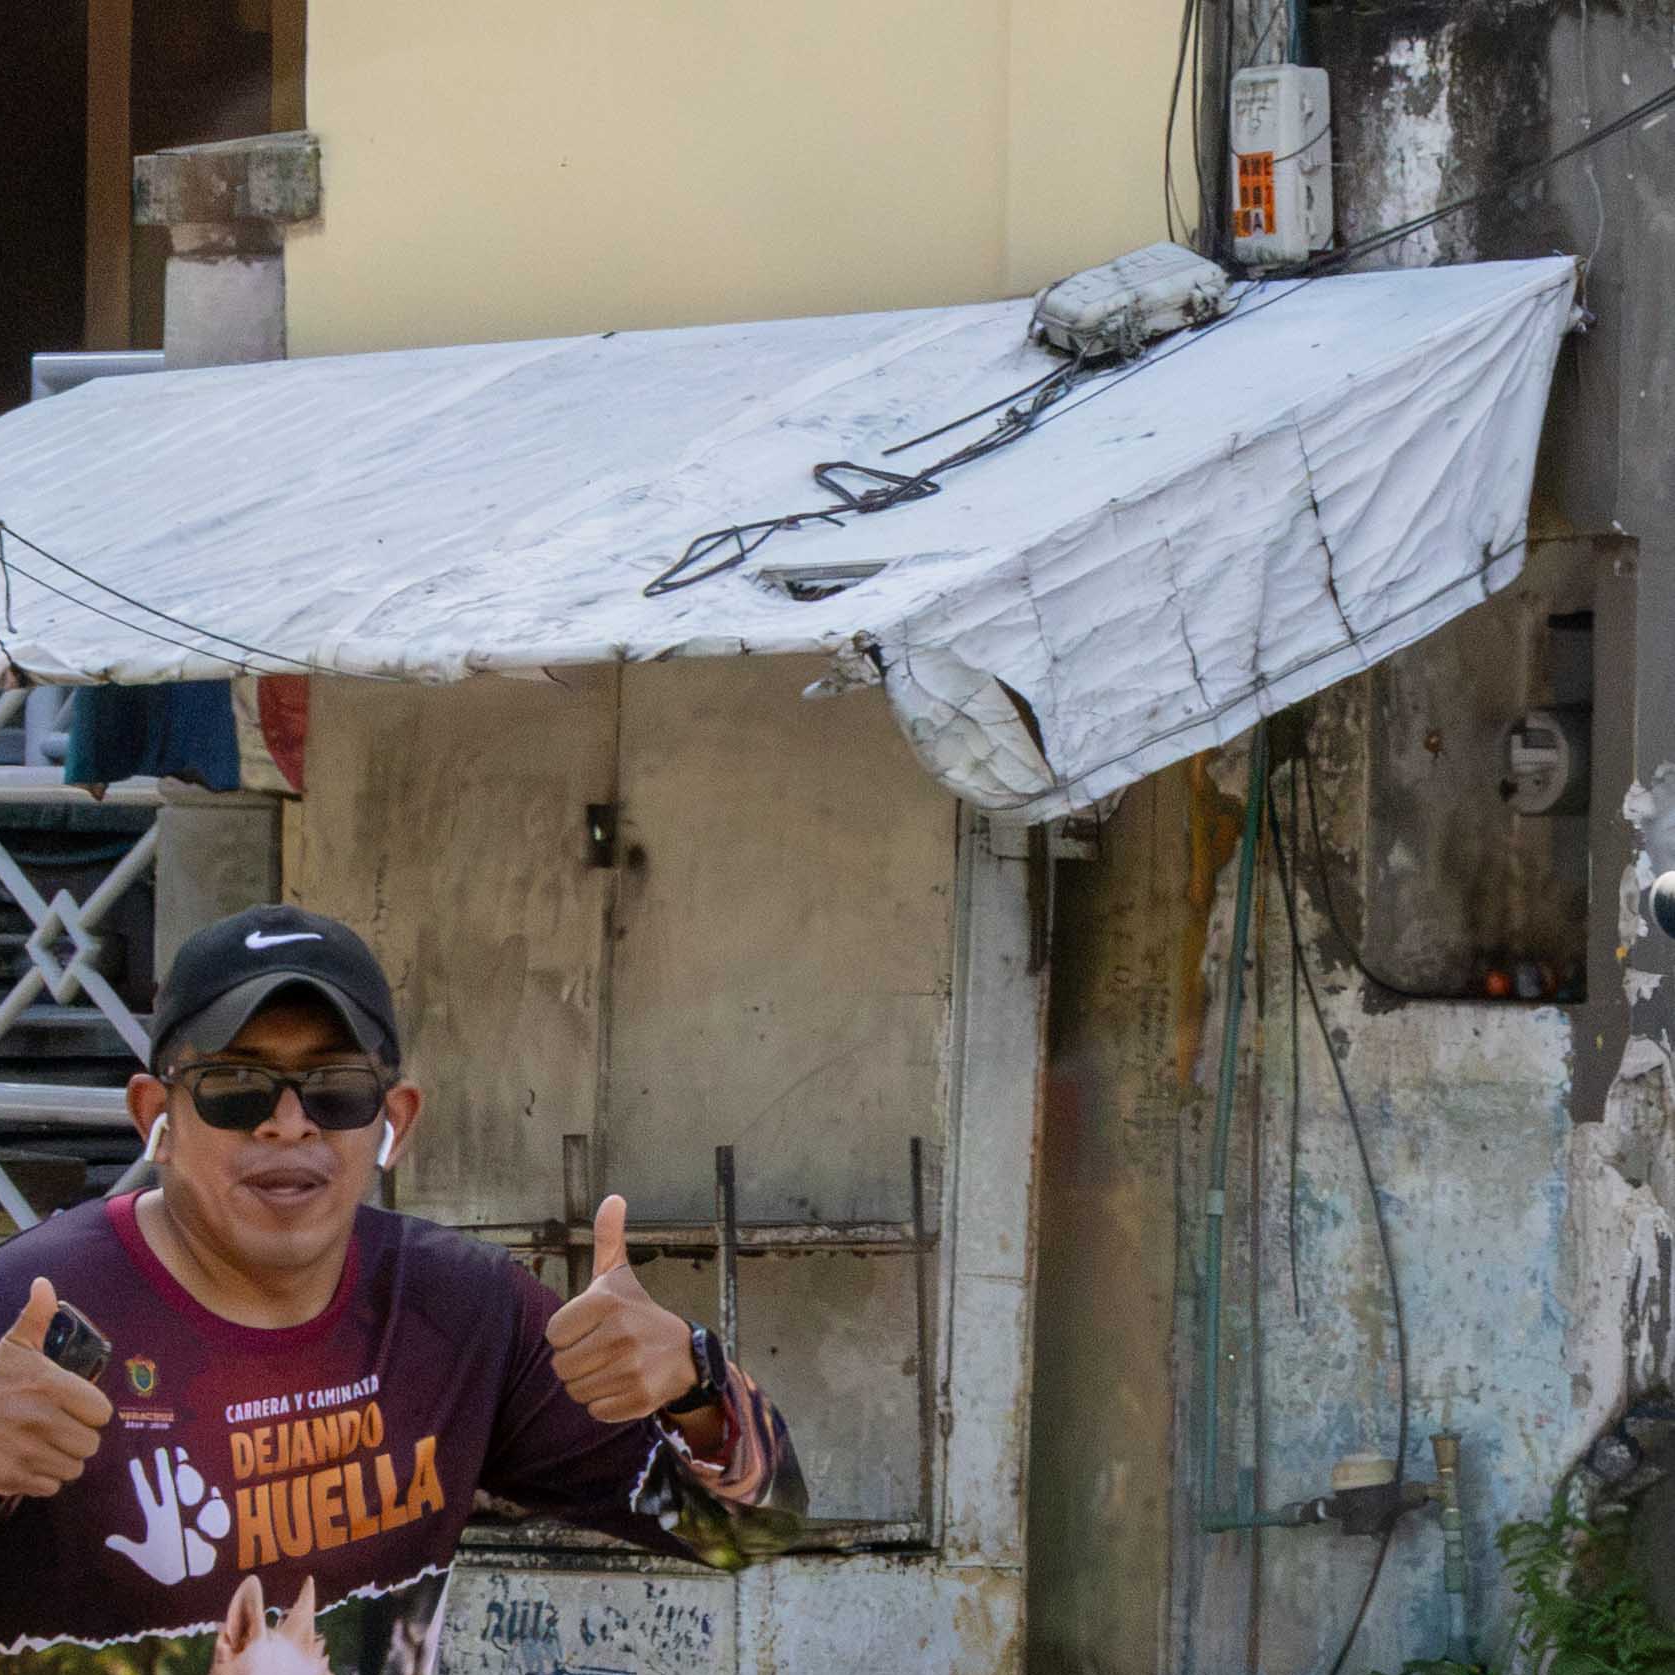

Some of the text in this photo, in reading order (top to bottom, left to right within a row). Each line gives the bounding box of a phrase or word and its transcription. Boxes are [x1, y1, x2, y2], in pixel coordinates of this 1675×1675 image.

[225, 1374, 380, 1424] CARRERA Y CAMINATA
[229, 1401, 384, 1480] DEJANDO
[235, 1435, 445, 1571] HUELLA
